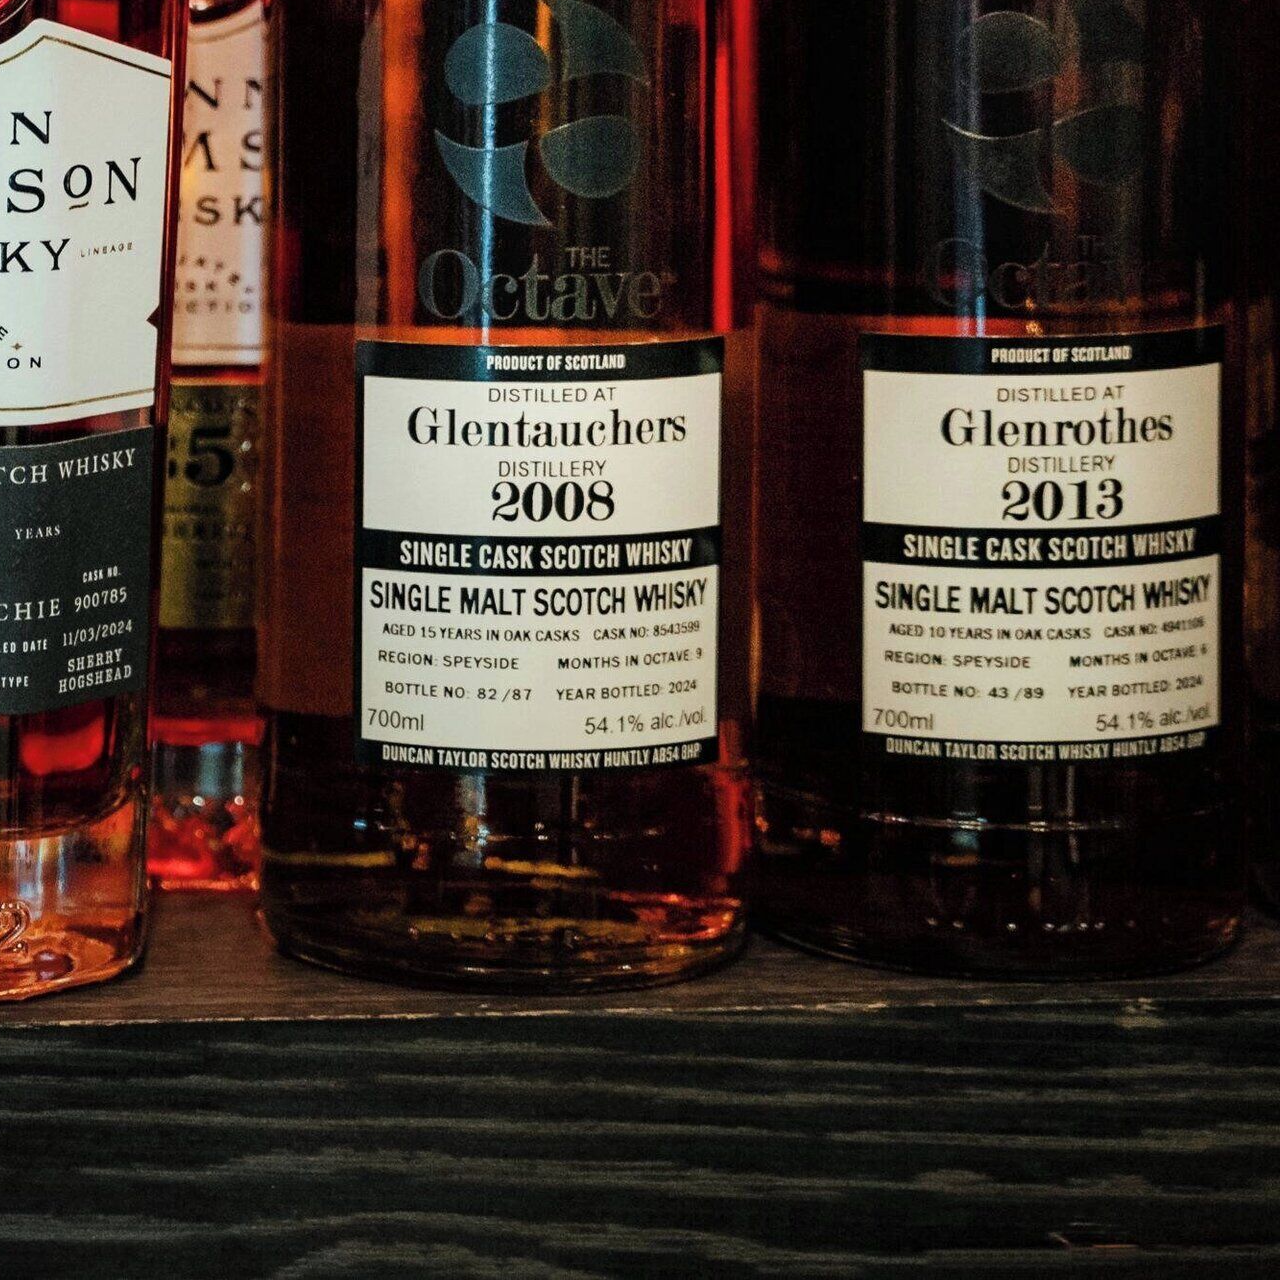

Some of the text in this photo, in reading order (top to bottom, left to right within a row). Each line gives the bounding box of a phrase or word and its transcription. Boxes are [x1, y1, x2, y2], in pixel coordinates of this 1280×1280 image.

[81, 242, 132, 257] LINEAGE
[565, 246, 610, 268] THE
[418, 248, 663, 321] Octave
[485, 354, 625, 370] PRODUCT OF SCOTLAND
[489, 387, 616, 402] DISTILLED AT
[997, 385, 1124, 402] DISTILLED AT
[408, 407, 686, 447] Glentauchers
[941, 407, 1173, 446] Glenrothes
[59, 448, 135, 478] WHISKY
[499, 460, 606, 477] DISTILLERY
[1008, 455, 1115, 473] DISTILLERY
[492, 481, 614, 522] 2008
[1002, 479, 1123, 521] 2013
[15, 525, 60, 539] YEARS
[400, 538, 692, 569] SINGLE CASK SCOTCH WHISKY
[83, 566, 121, 582] CASK NO.
[75, 587, 126, 612] 900785
[370, 578, 706, 616] SINGLE MALT SCOTCH WHISKY
[875, 574, 1210, 614] SINGLE MALT SCOTCH WHISKY
[23, 639, 47, 652] DATE
[63, 620, 132, 646] 11/03/2024
[67, 649, 123, 672] SHERRY
[443, 656, 518, 669] SPEYSIDE
[953, 655, 1030, 668] SPEYSIDE
[2, 676, 28, 688] TYPE
[58, 665, 132, 693] HOGSHEAD
[368, 708, 423, 730] 700ml
